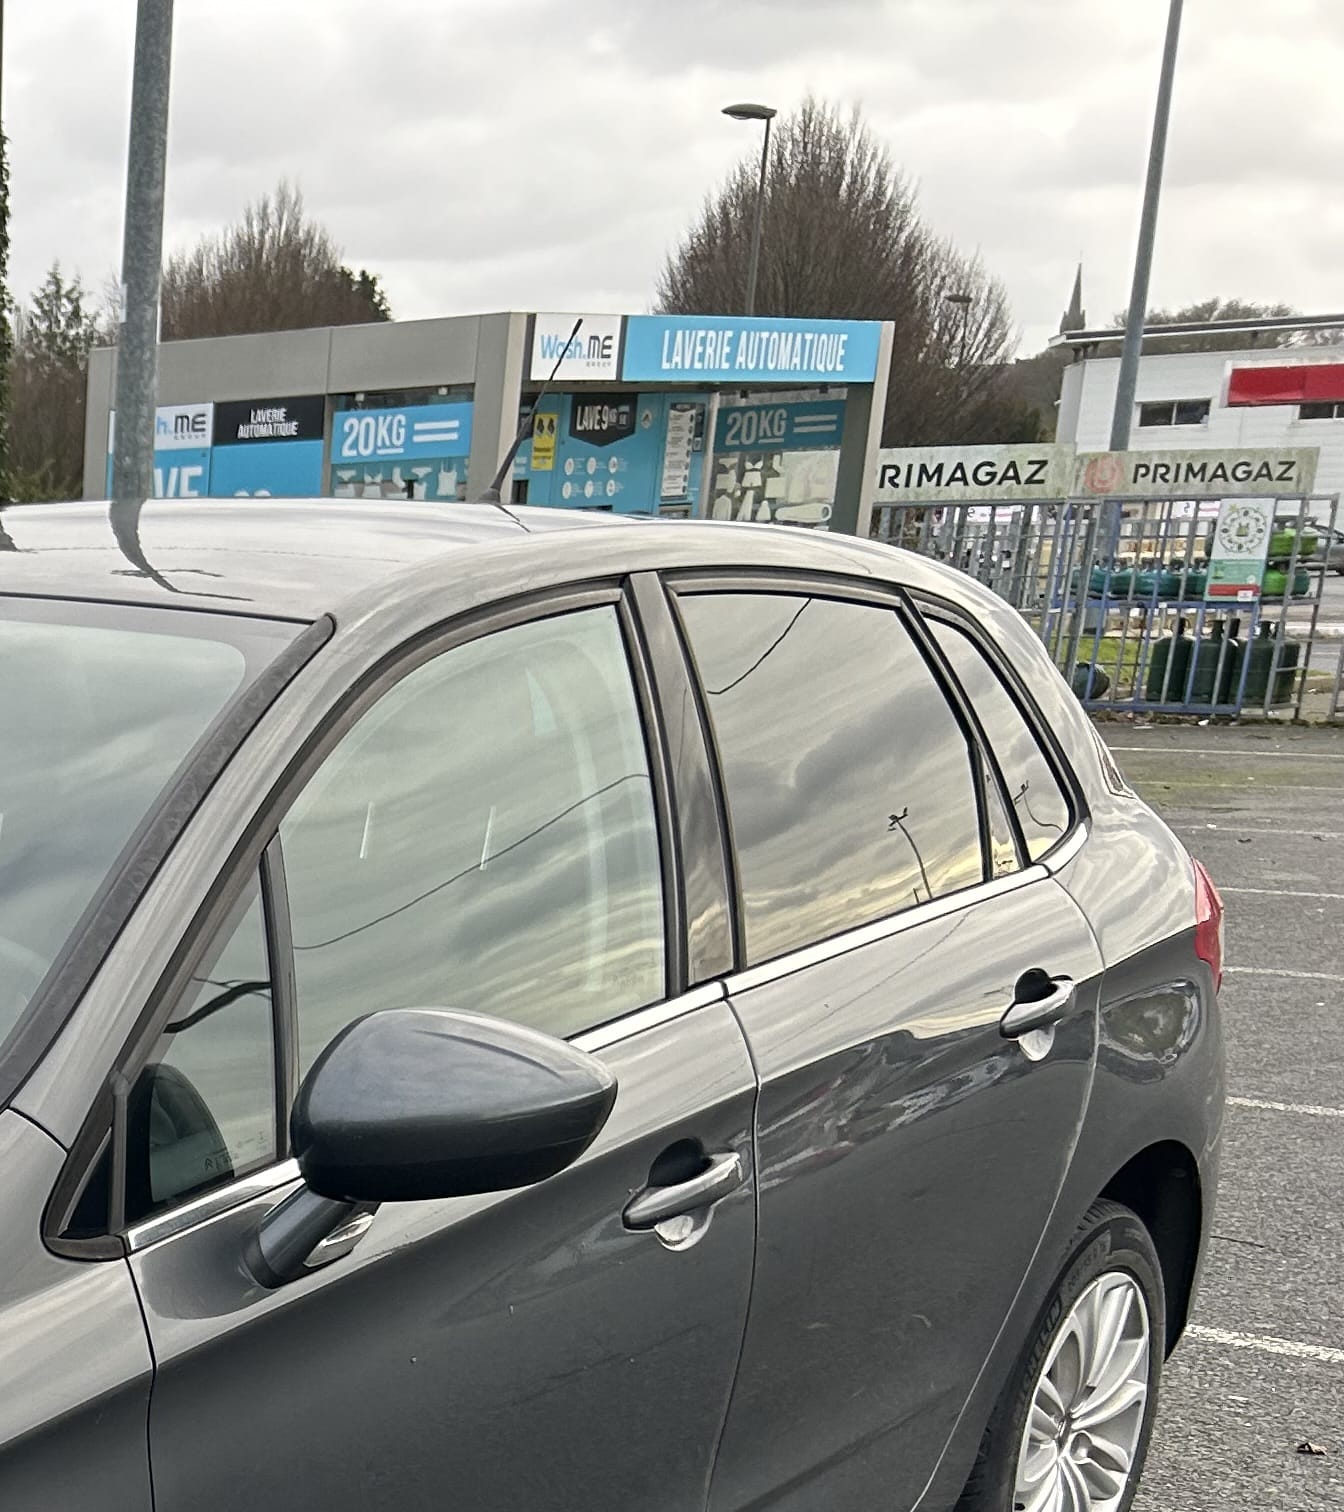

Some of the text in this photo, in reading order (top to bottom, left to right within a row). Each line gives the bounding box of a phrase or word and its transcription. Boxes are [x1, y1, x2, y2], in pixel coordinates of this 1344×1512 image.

[662, 330, 849, 373] LAVERIE AUTOMATIQUE
[341, 413, 407, 457] 20KG
[725, 408, 788, 446] 20KG
[879, 460, 1049, 489] RIMAGAZ
[1132, 460, 1297, 485] PRIMAGAZ
